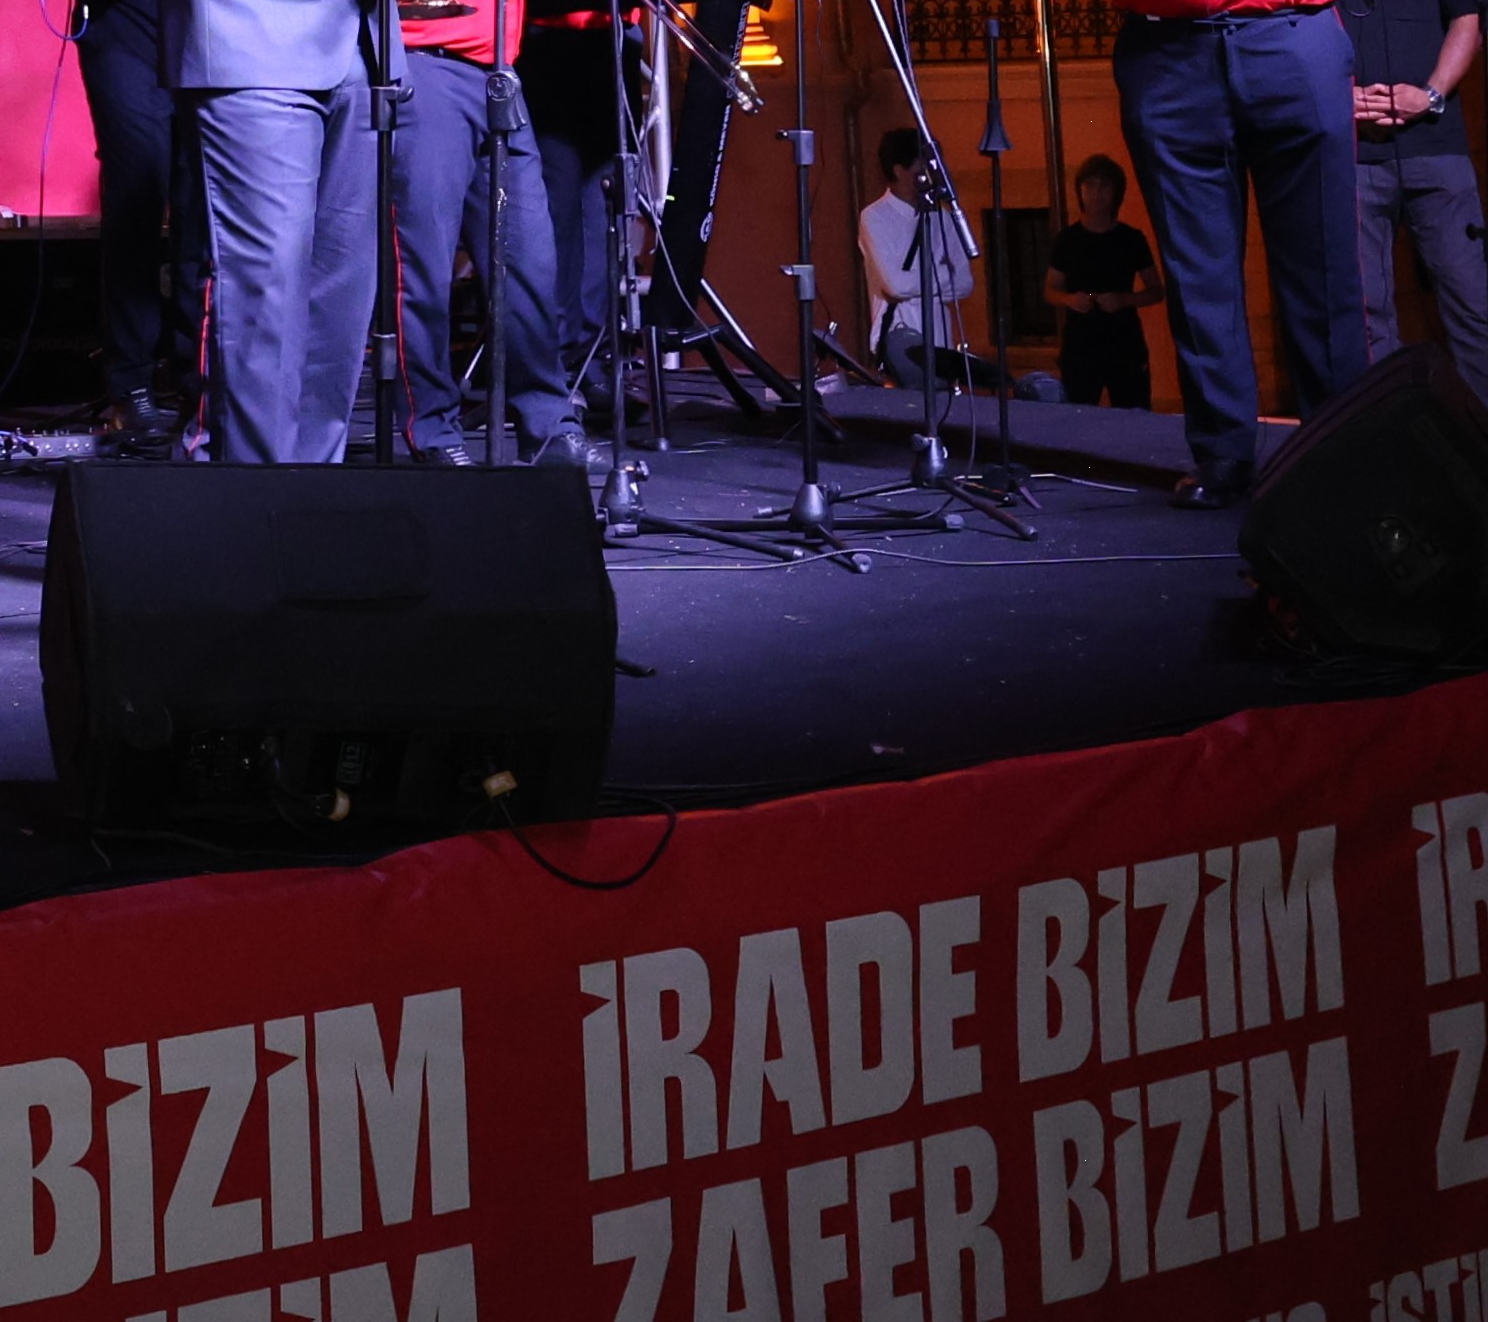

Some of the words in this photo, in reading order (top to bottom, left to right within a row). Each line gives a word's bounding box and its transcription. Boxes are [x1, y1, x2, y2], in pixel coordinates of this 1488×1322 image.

[579, 895, 983, 1182] İRADE
[1017, 824, 1345, 1084] BİZİM
[591, 1125, 1008, 1322] ZAFER
[1033, 1036, 1361, 1305] BİZİM
